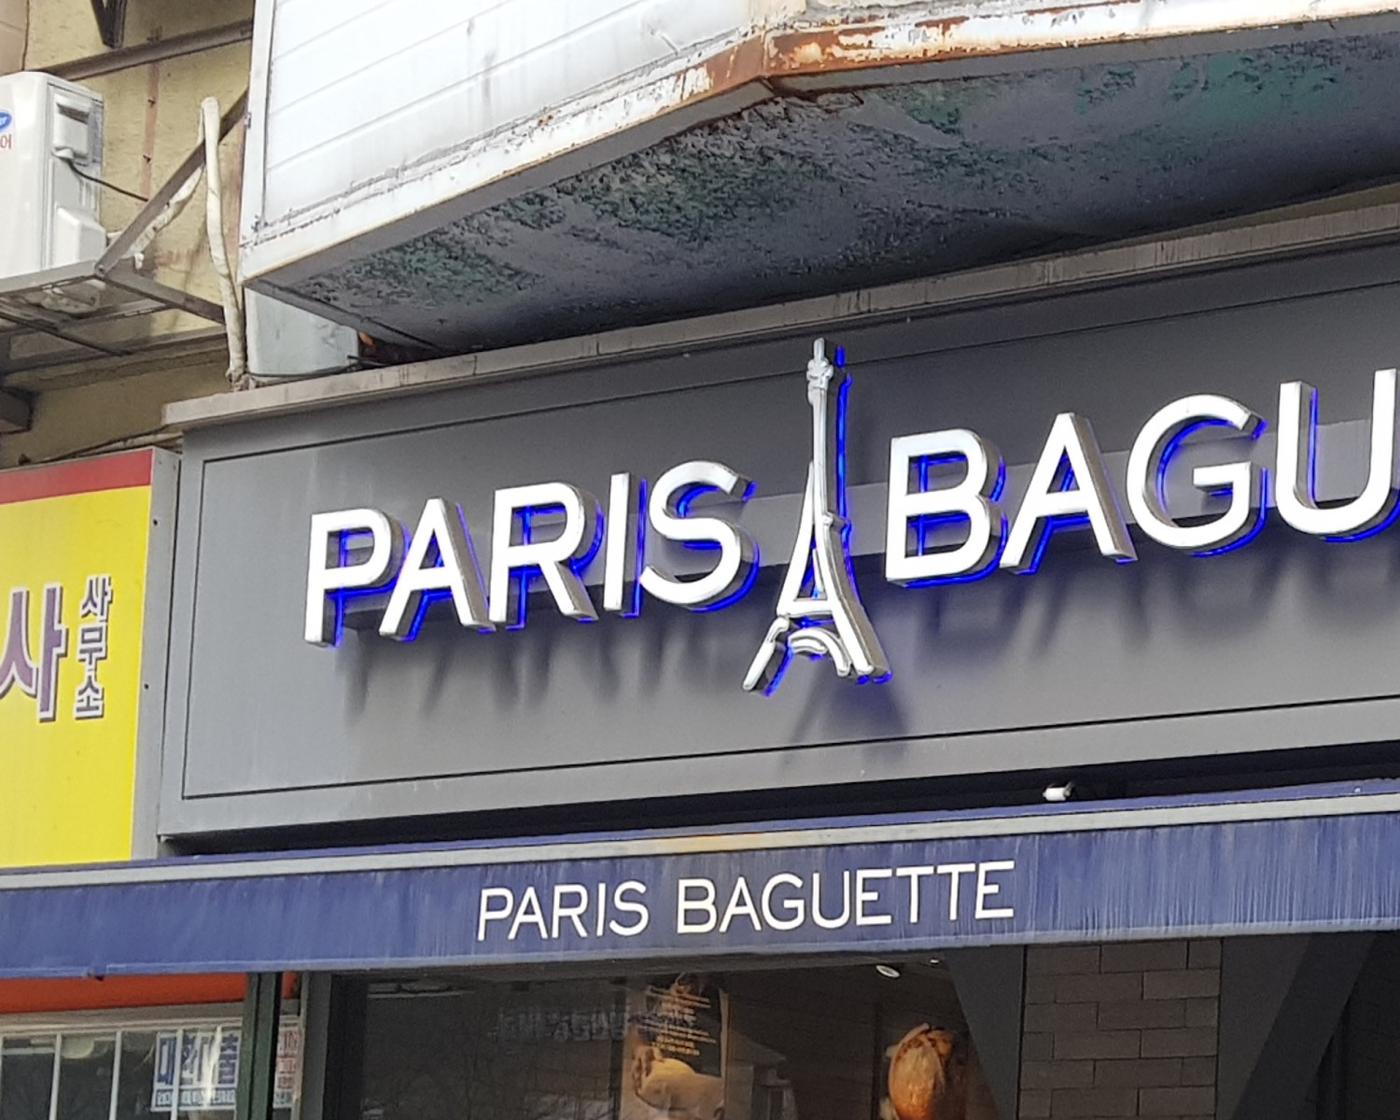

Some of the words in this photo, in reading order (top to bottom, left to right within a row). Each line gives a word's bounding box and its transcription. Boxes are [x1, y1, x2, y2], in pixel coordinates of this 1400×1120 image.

[303, 459, 756, 650] PARIS
[74, 574, 113, 720] 사무소
[477, 880, 650, 941] PARIS
[676, 860, 1016, 935] BAGUETTE
